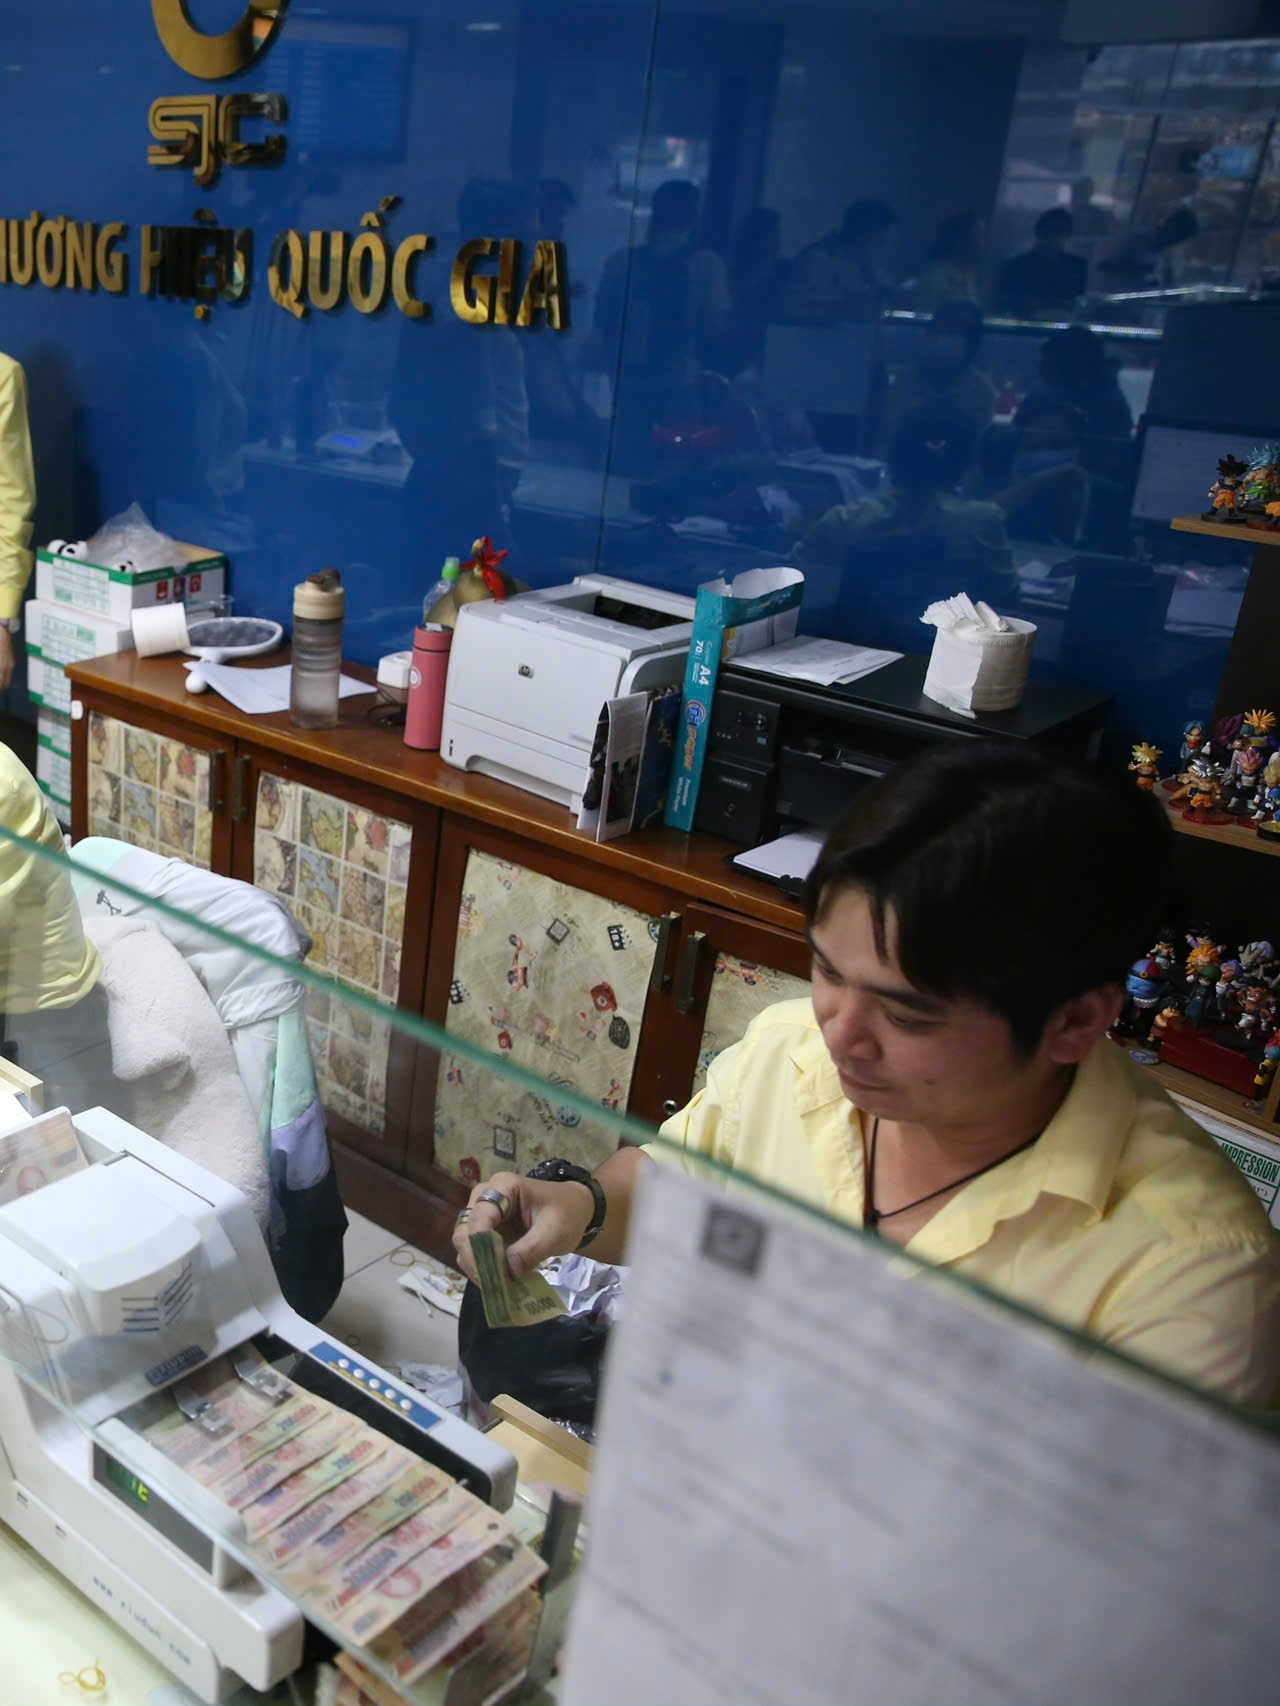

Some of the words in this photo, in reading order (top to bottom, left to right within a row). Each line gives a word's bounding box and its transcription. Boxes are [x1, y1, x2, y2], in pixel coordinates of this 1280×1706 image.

[147, 92, 287, 187] SJC
[267, 195, 434, 319] QUỐC
[449, 237, 571, 329] GIA
[698, 664, 712, 686] A4
